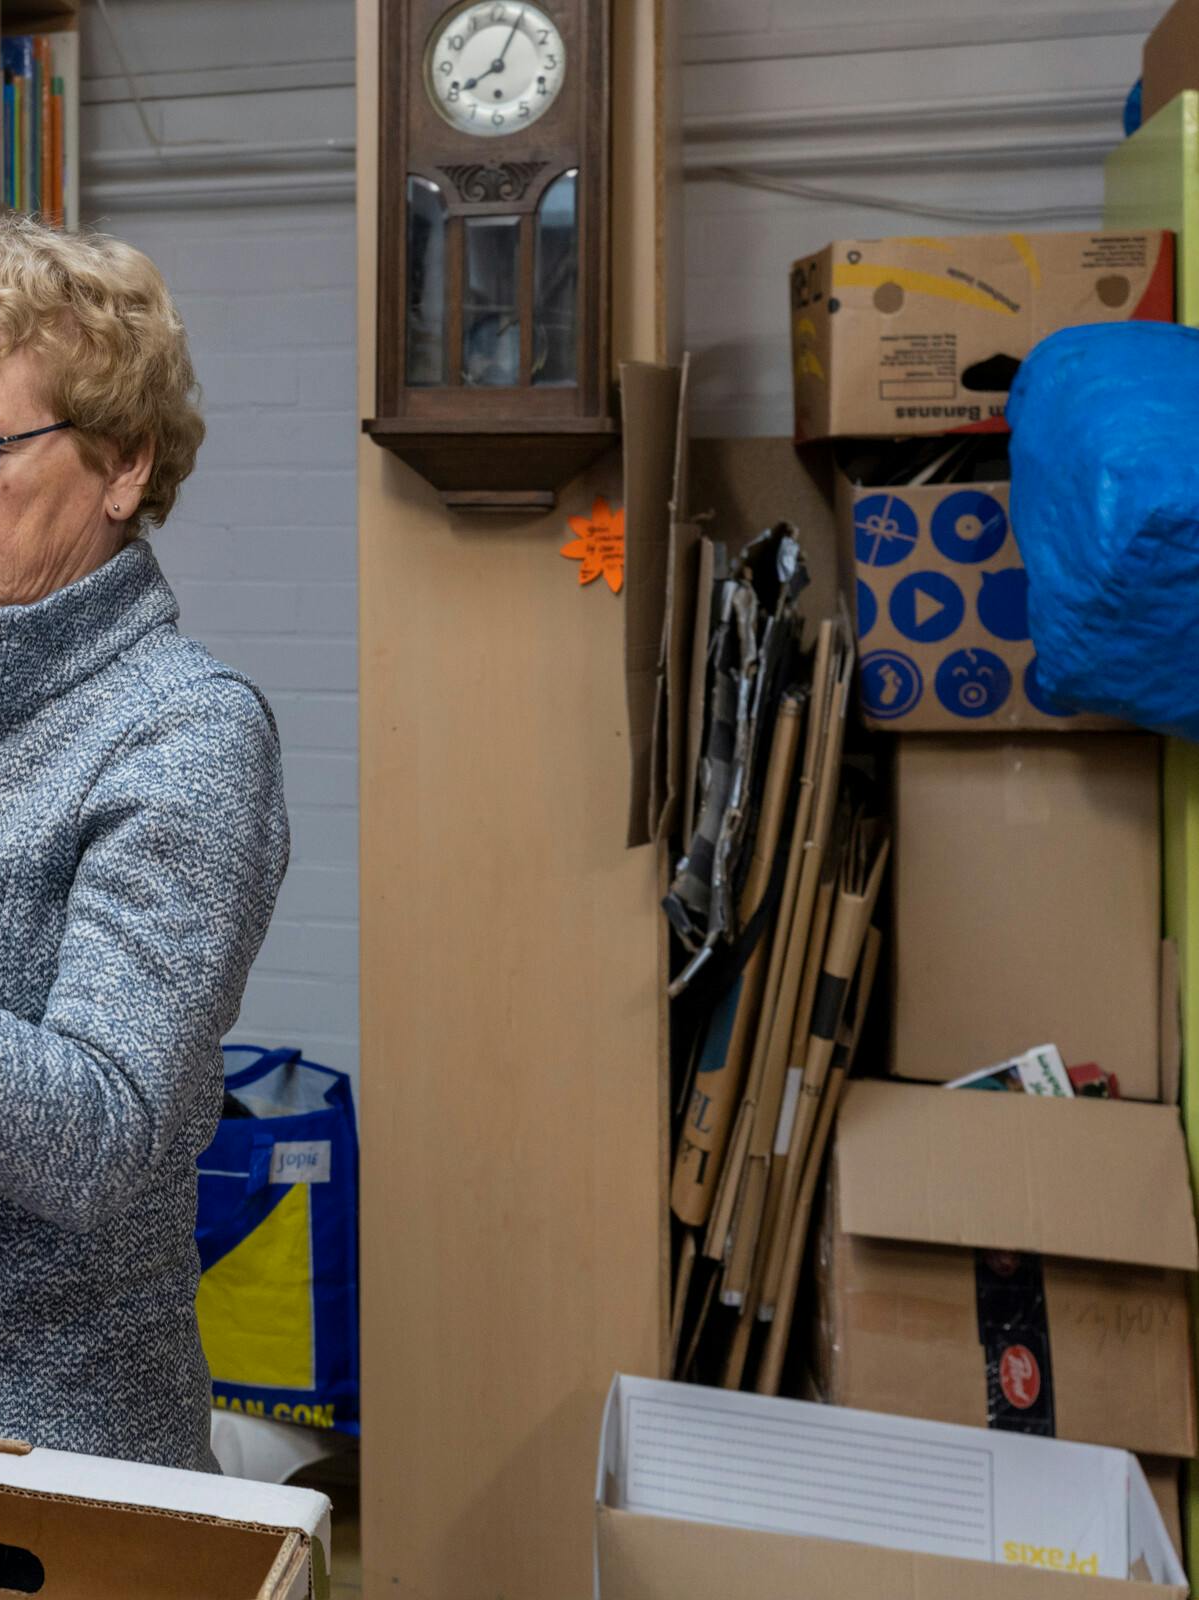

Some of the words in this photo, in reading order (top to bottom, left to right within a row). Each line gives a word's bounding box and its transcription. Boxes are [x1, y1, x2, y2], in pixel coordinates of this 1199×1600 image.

[448, 35, 465, 51] 10
[536, 29, 549, 45] 2
[440, 61, 453, 76] 9
[544, 54, 557, 70] 3
[468, 104, 478, 120] 7
[491, 108, 504, 126] 6
[518, 101, 530, 118] 5
[895, 405, 981, 422] Bananas
[1002, 1541, 1099, 1577] Praxis
